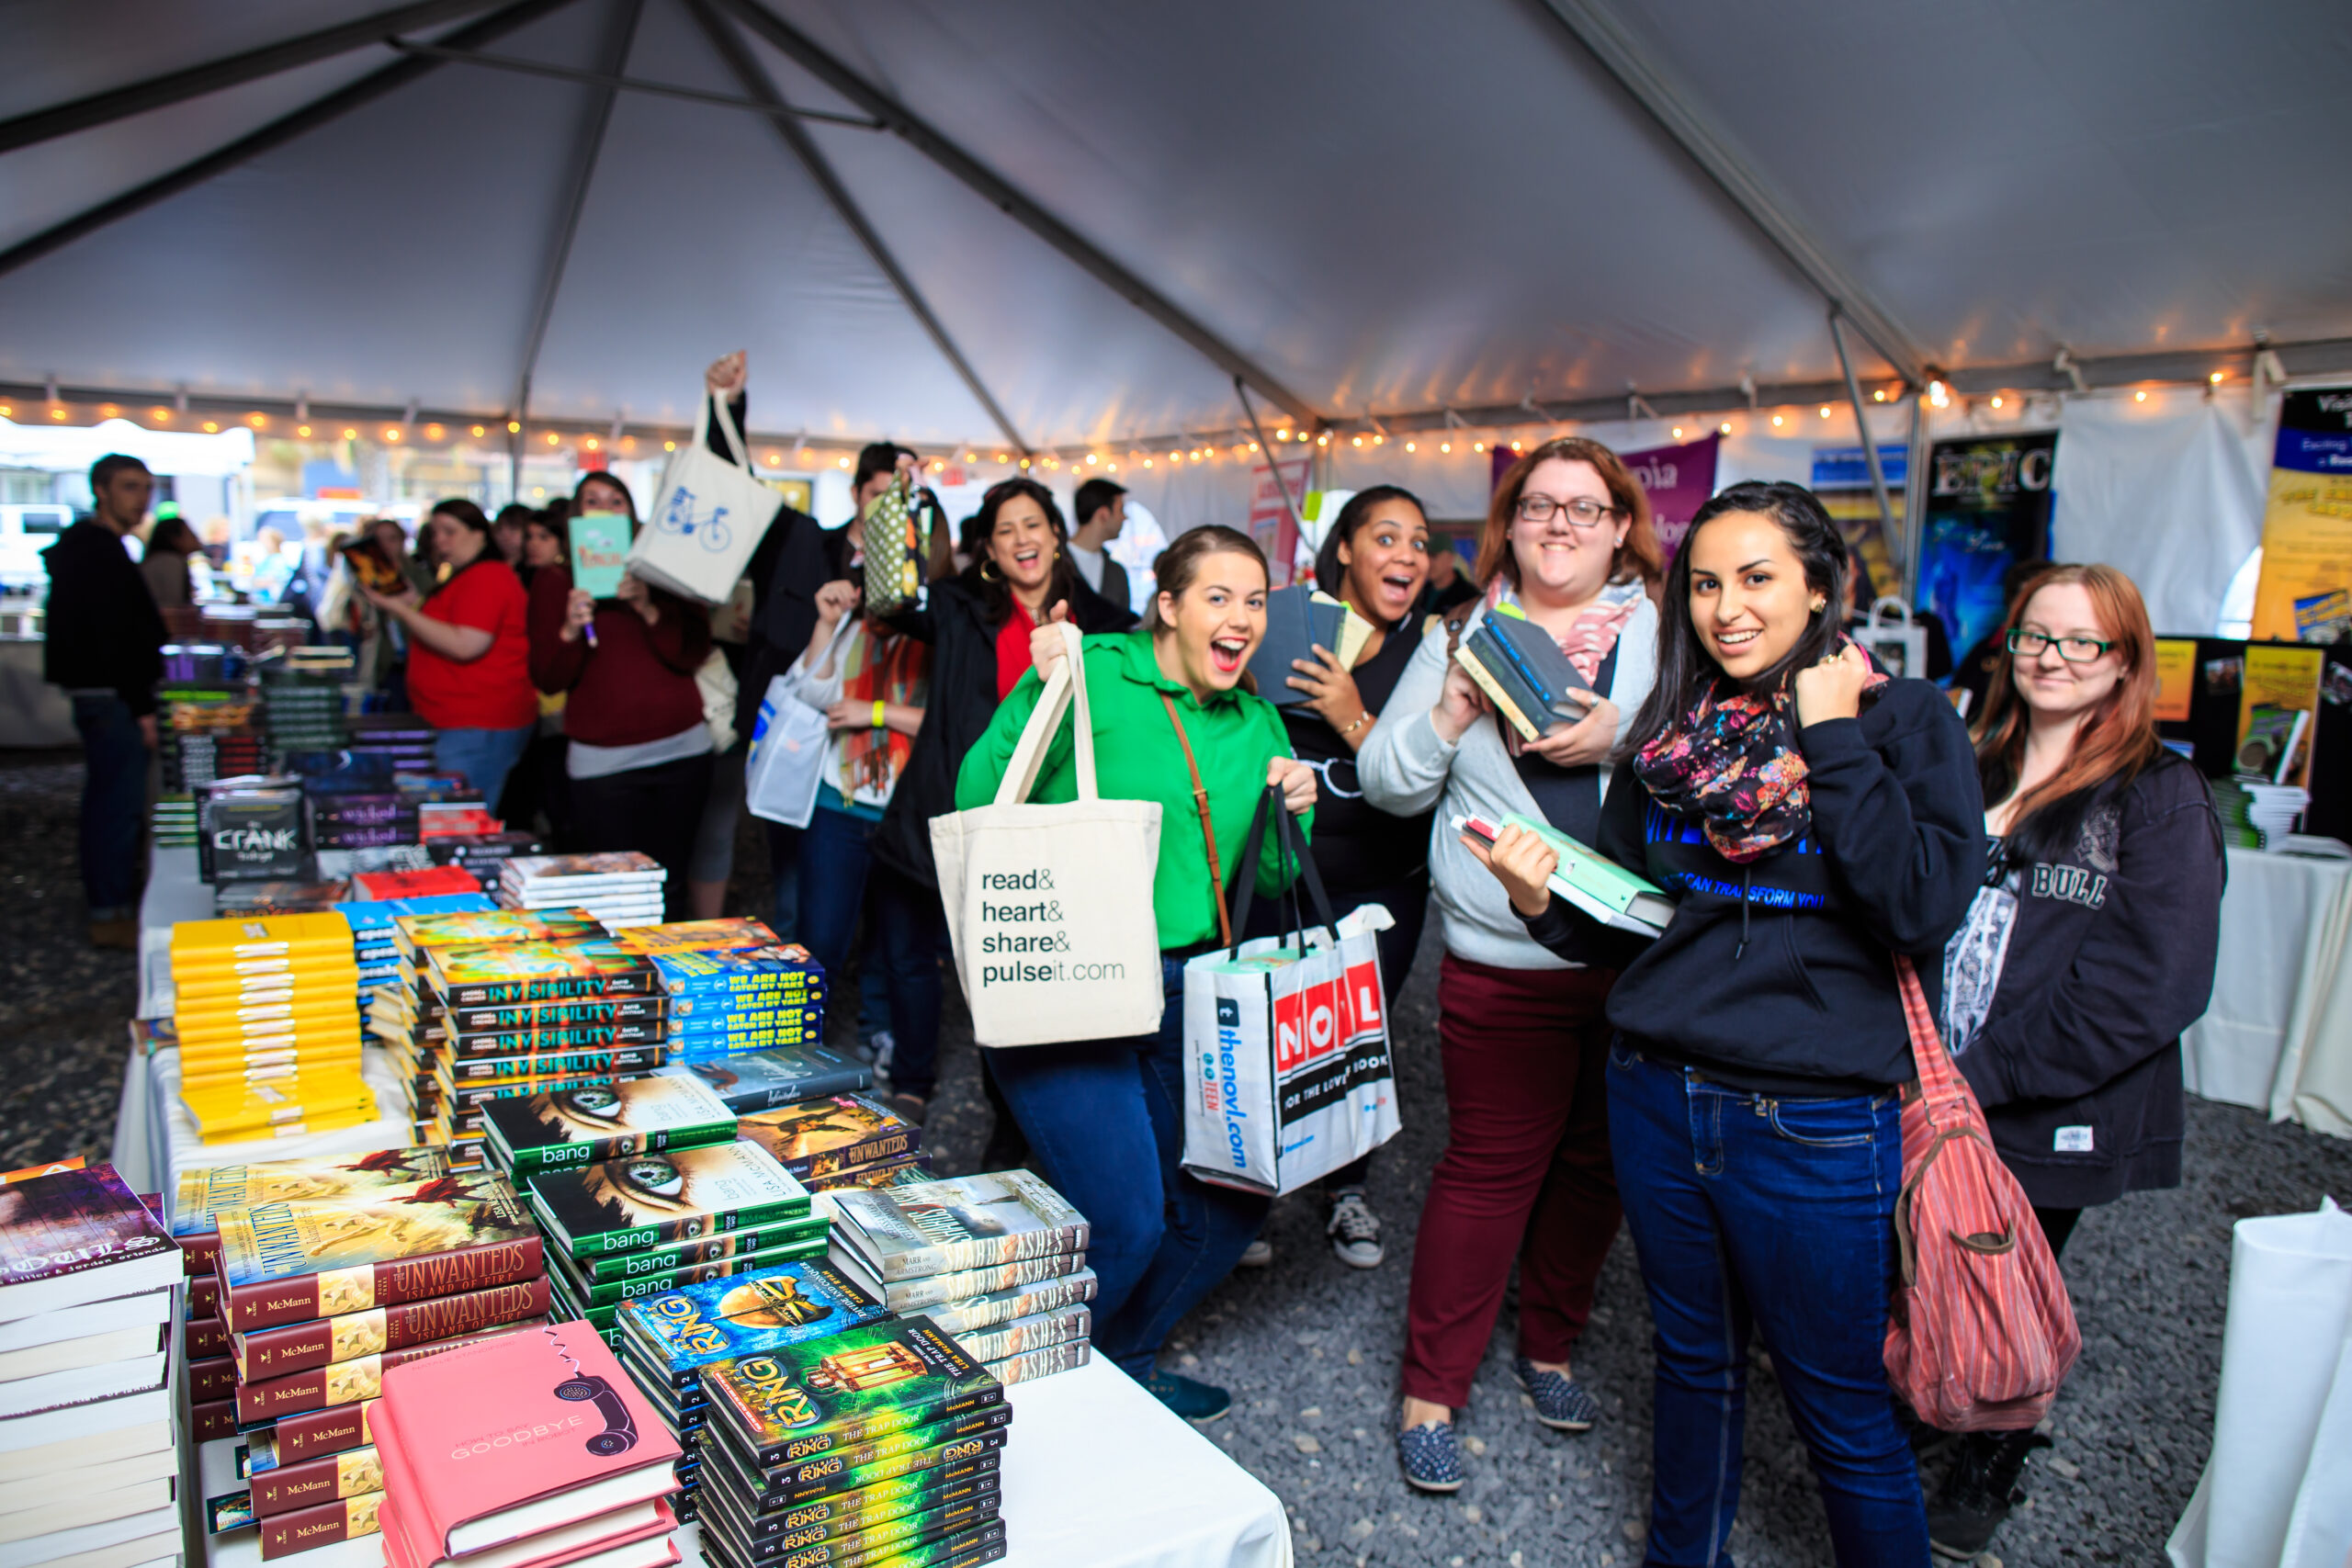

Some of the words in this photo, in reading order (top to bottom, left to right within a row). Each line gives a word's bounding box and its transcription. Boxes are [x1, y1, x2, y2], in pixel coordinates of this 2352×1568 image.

[982, 869, 1055, 890] read&
[1714, 880, 1794, 908] TRASFORM
[982, 899, 1064, 921] heart&
[982, 931, 1070, 953] share&
[729, 976, 748, 984] WE
[983, 960, 1125, 987] pulseit.com
[489, 979, 606, 1001] INVISIBILITY
[736, 994, 753, 1002] WE
[499, 1004, 617, 1026] INVISIBILITY
[727, 1013, 746, 1022] WE
[1278, 987, 1381, 1062] NOL
[499, 1028, 616, 1051] INVISIBILITY
[728, 1032, 746, 1042] WE
[496, 1054, 614, 1076] INVISIBILITY
[1219, 1027, 1248, 1168] thenovl.com
[1285, 1093, 1300, 1110] OR
[1304, 1084, 1320, 1100] THE
[542, 1145, 590, 1164] bang
[848, 1134, 908, 1164] UNWANTEDS
[249, 1202, 308, 1275] UNWANTEDS
[603, 1229, 654, 1250] bang
[69, 1258, 112, 1272] jordan
[119, 1246, 167, 1260] orlando
[396, 1244, 525, 1292] UNWANTEDS
[627, 1253, 676, 1275] bang
[902, 1257, 922, 1266] MARR
[393, 1271, 405, 1282] THE
[896, 1264, 936, 1275] ARMSTRONG
[406, 1284, 454, 1301] ISLAND
[462, 1279, 477, 1290] OF
[485, 1272, 514, 1286] FIRE
[622, 1278, 673, 1298] bang
[905, 1291, 923, 1300] MARR
[266, 1297, 311, 1312] McMann
[407, 1281, 533, 1335] UNWANTEDS
[899, 1297, 939, 1309] ARMSTRONG
[416, 1324, 465, 1342] ISLAND
[472, 1317, 486, 1329] OF
[493, 1311, 524, 1324] FIRE
[908, 1327, 929, 1348] DOOR
[922, 1328, 953, 1356] McMANN
[281, 1343, 325, 1358] McMann
[927, 1345, 947, 1364] TRAP
[945, 1360, 963, 1377] THE
[954, 1354, 970, 1370] LISA
[275, 1386, 319, 1401] McMann
[946, 1399, 975, 1413] McMANN
[312, 1427, 356, 1442] McMann
[842, 1429, 863, 1440] THE
[865, 1421, 889, 1436] TRAP
[891, 1414, 920, 1429] DOOR
[956, 1421, 985, 1434] McMANN
[451, 1415, 584, 1460] GOODBYE
[788, 1438, 831, 1459] RING
[854, 1451, 874, 1463] THE
[876, 1443, 899, 1459] TRAP
[902, 1435, 930, 1450] DOOR
[945, 1440, 982, 1458] RING
[800, 1461, 842, 1482] RING
[885, 1461, 910, 1474] TRAP
[912, 1458, 933, 1468] THE
[945, 1466, 974, 1479] McMANN
[855, 1469, 884, 1483] DOOR
[287, 1480, 331, 1495] McMann
[795, 1485, 826, 1499] McMANN
[842, 1498, 862, 1509] THE
[864, 1490, 888, 1505] TRAP
[890, 1481, 919, 1496] DOOR
[943, 1487, 971, 1500] McMANN
[787, 1508, 830, 1528] RING
[839, 1520, 858, 1531] THE
[861, 1512, 886, 1526] TRAP
[888, 1502, 916, 1518] DOOR
[945, 1506, 974, 1519] McMANN
[296, 1521, 340, 1539] McMann
[944, 1517, 971, 1532] McMANN
[785, 1530, 826, 1550] RING
[842, 1540, 862, 1552] THE
[864, 1531, 888, 1546] TRAP
[890, 1521, 919, 1539] DOOR
[951, 1538, 978, 1552] McMANN
[787, 1550, 830, 1568] RING
[842, 1555, 863, 1568] THE
[865, 1546, 889, 1562] TRAP
[891, 1536, 919, 1553] DOOR
